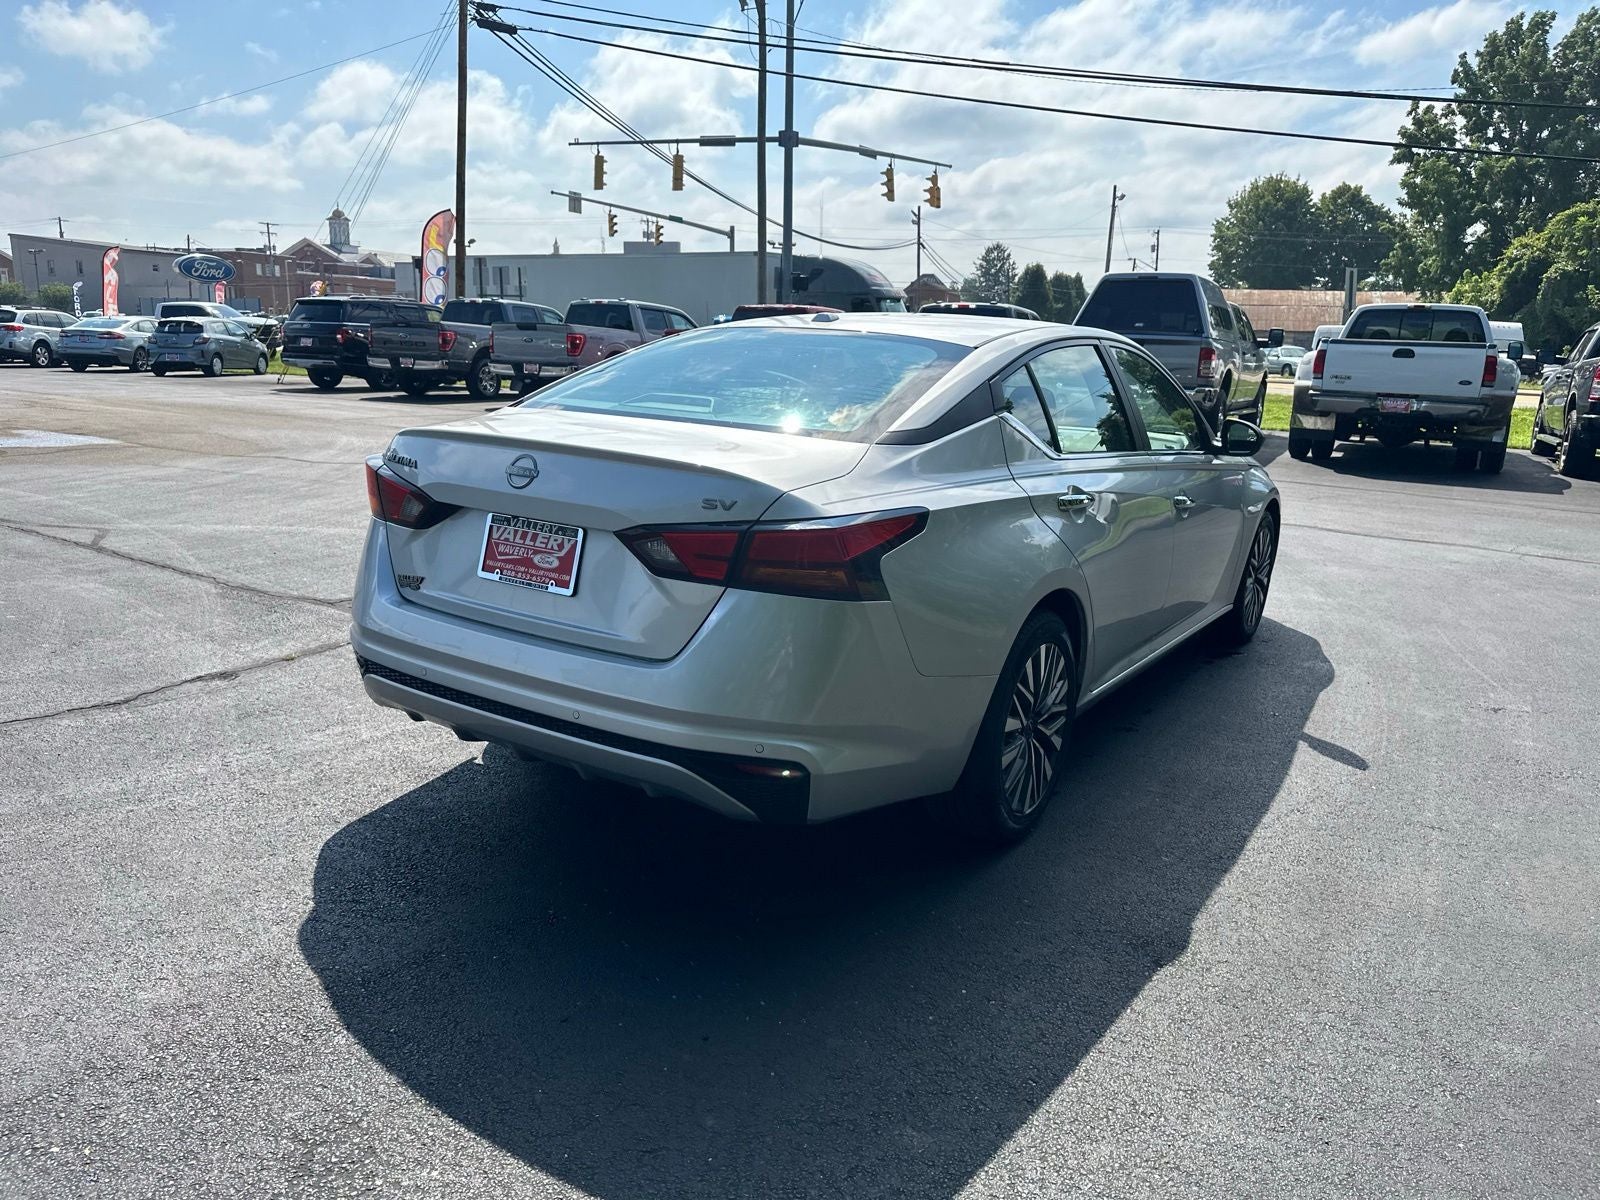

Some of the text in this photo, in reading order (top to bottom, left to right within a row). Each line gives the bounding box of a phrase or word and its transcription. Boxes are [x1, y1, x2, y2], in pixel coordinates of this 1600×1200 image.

[191, 260, 226, 279] Ford
[73, 288, 83, 317] FORD
[506, 466, 538, 477] NISSAN
[701, 498, 738, 511] SV
[510, 518, 558, 535] VALLERY
[491, 525, 576, 555] VALLERY
[538, 555, 555, 566] Ford
[502, 570, 550, 583] 888-853-6579
